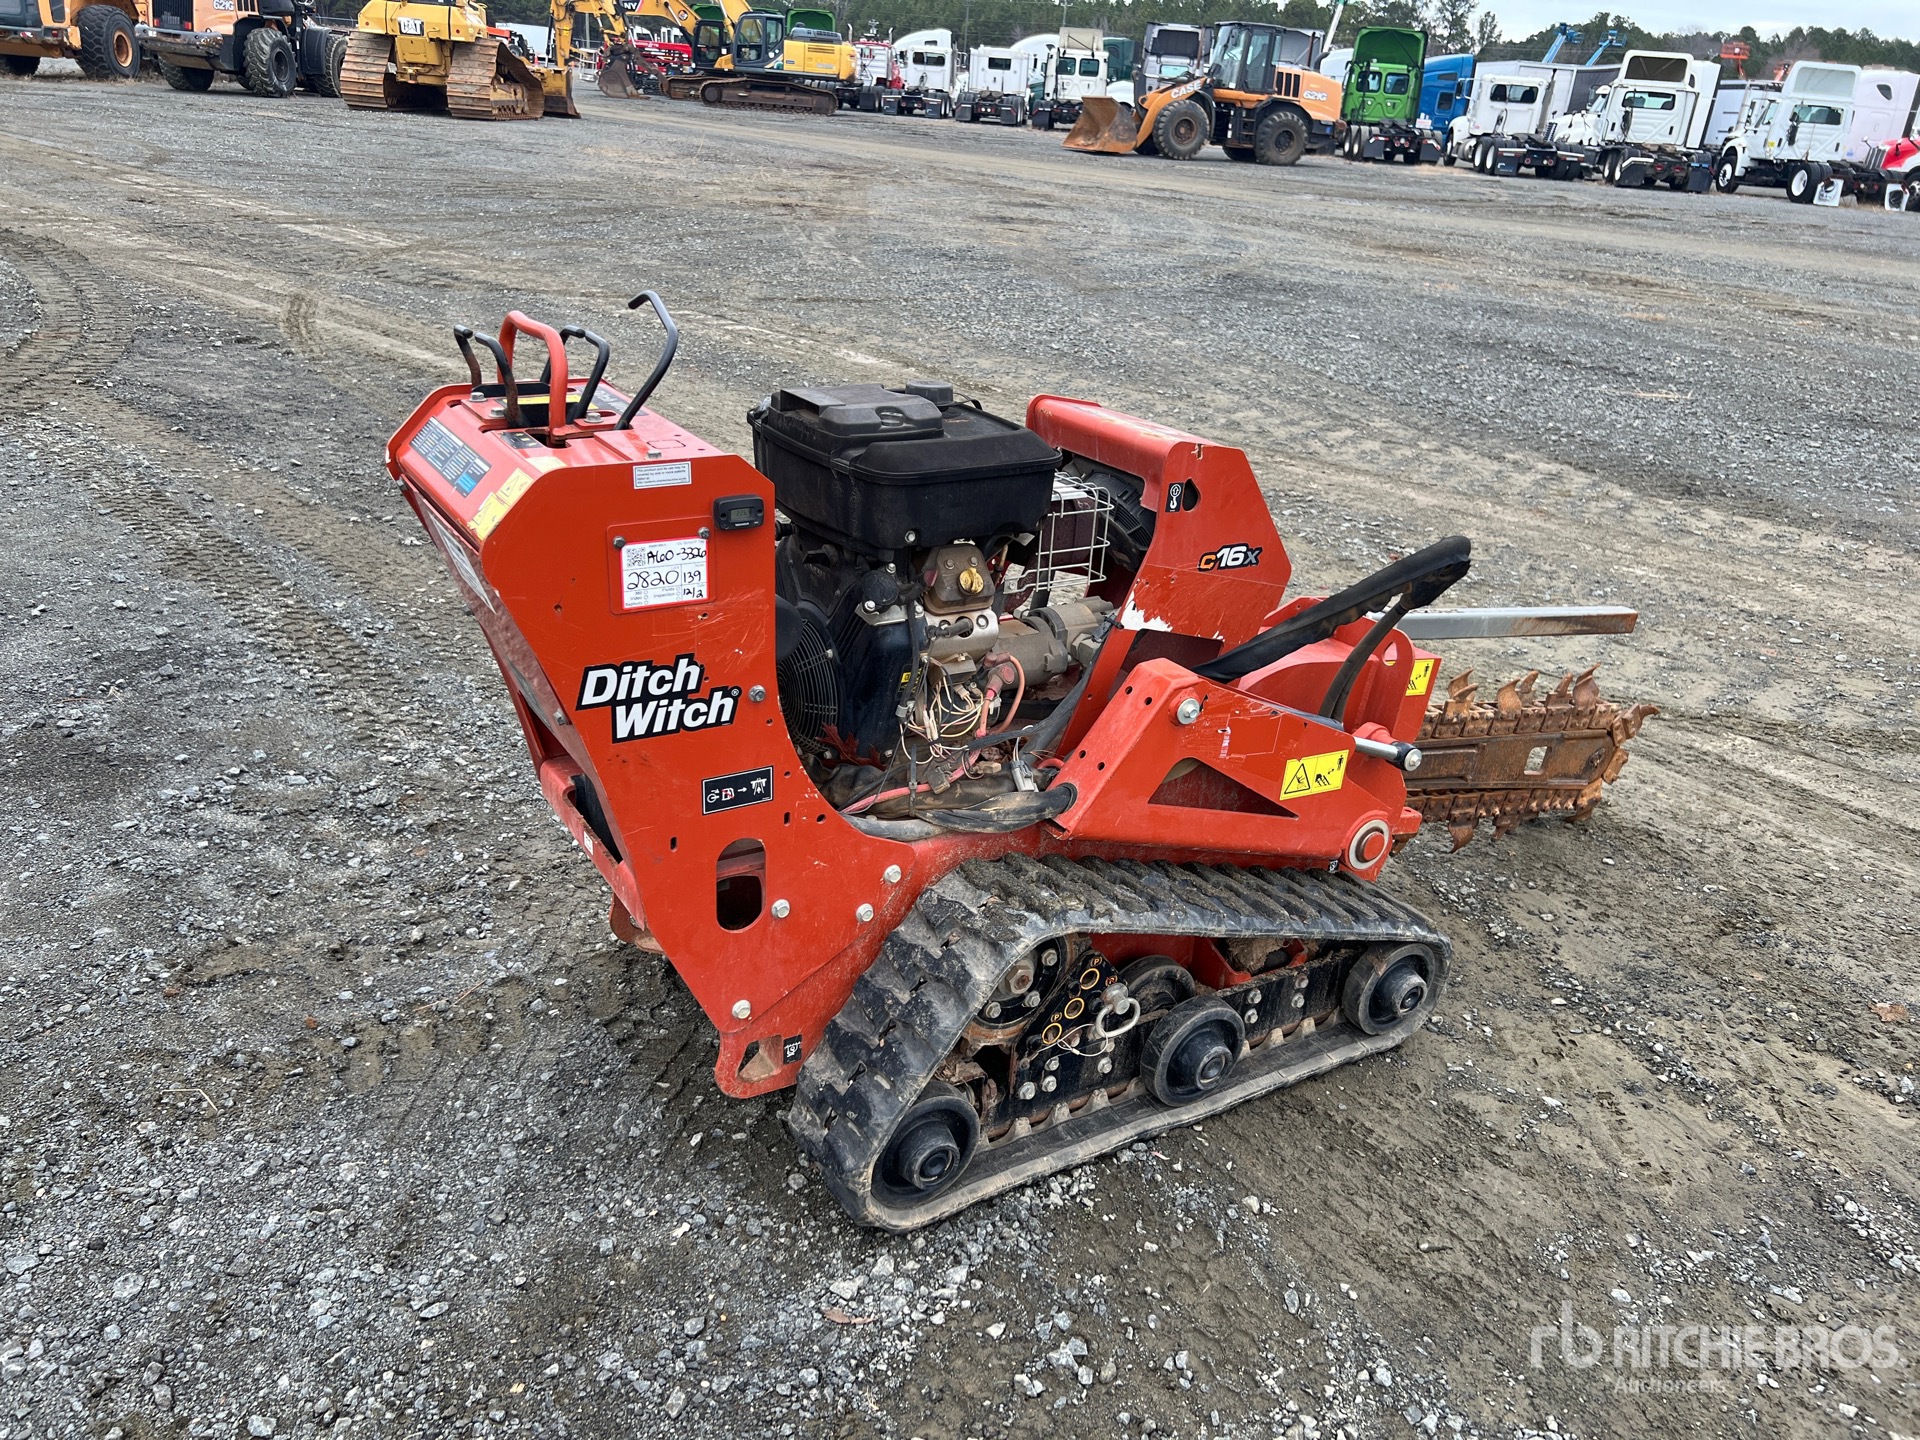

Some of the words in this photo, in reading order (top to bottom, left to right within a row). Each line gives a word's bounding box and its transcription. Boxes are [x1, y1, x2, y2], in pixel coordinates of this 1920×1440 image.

[400, 19, 421, 35] CAT
[1171, 80, 1201, 98] CASE
[1303, 90, 1328, 101] 621G
[627, 570, 680, 590] 2820
[683, 570, 702, 584] 139
[581, 658, 701, 706] Ditch
